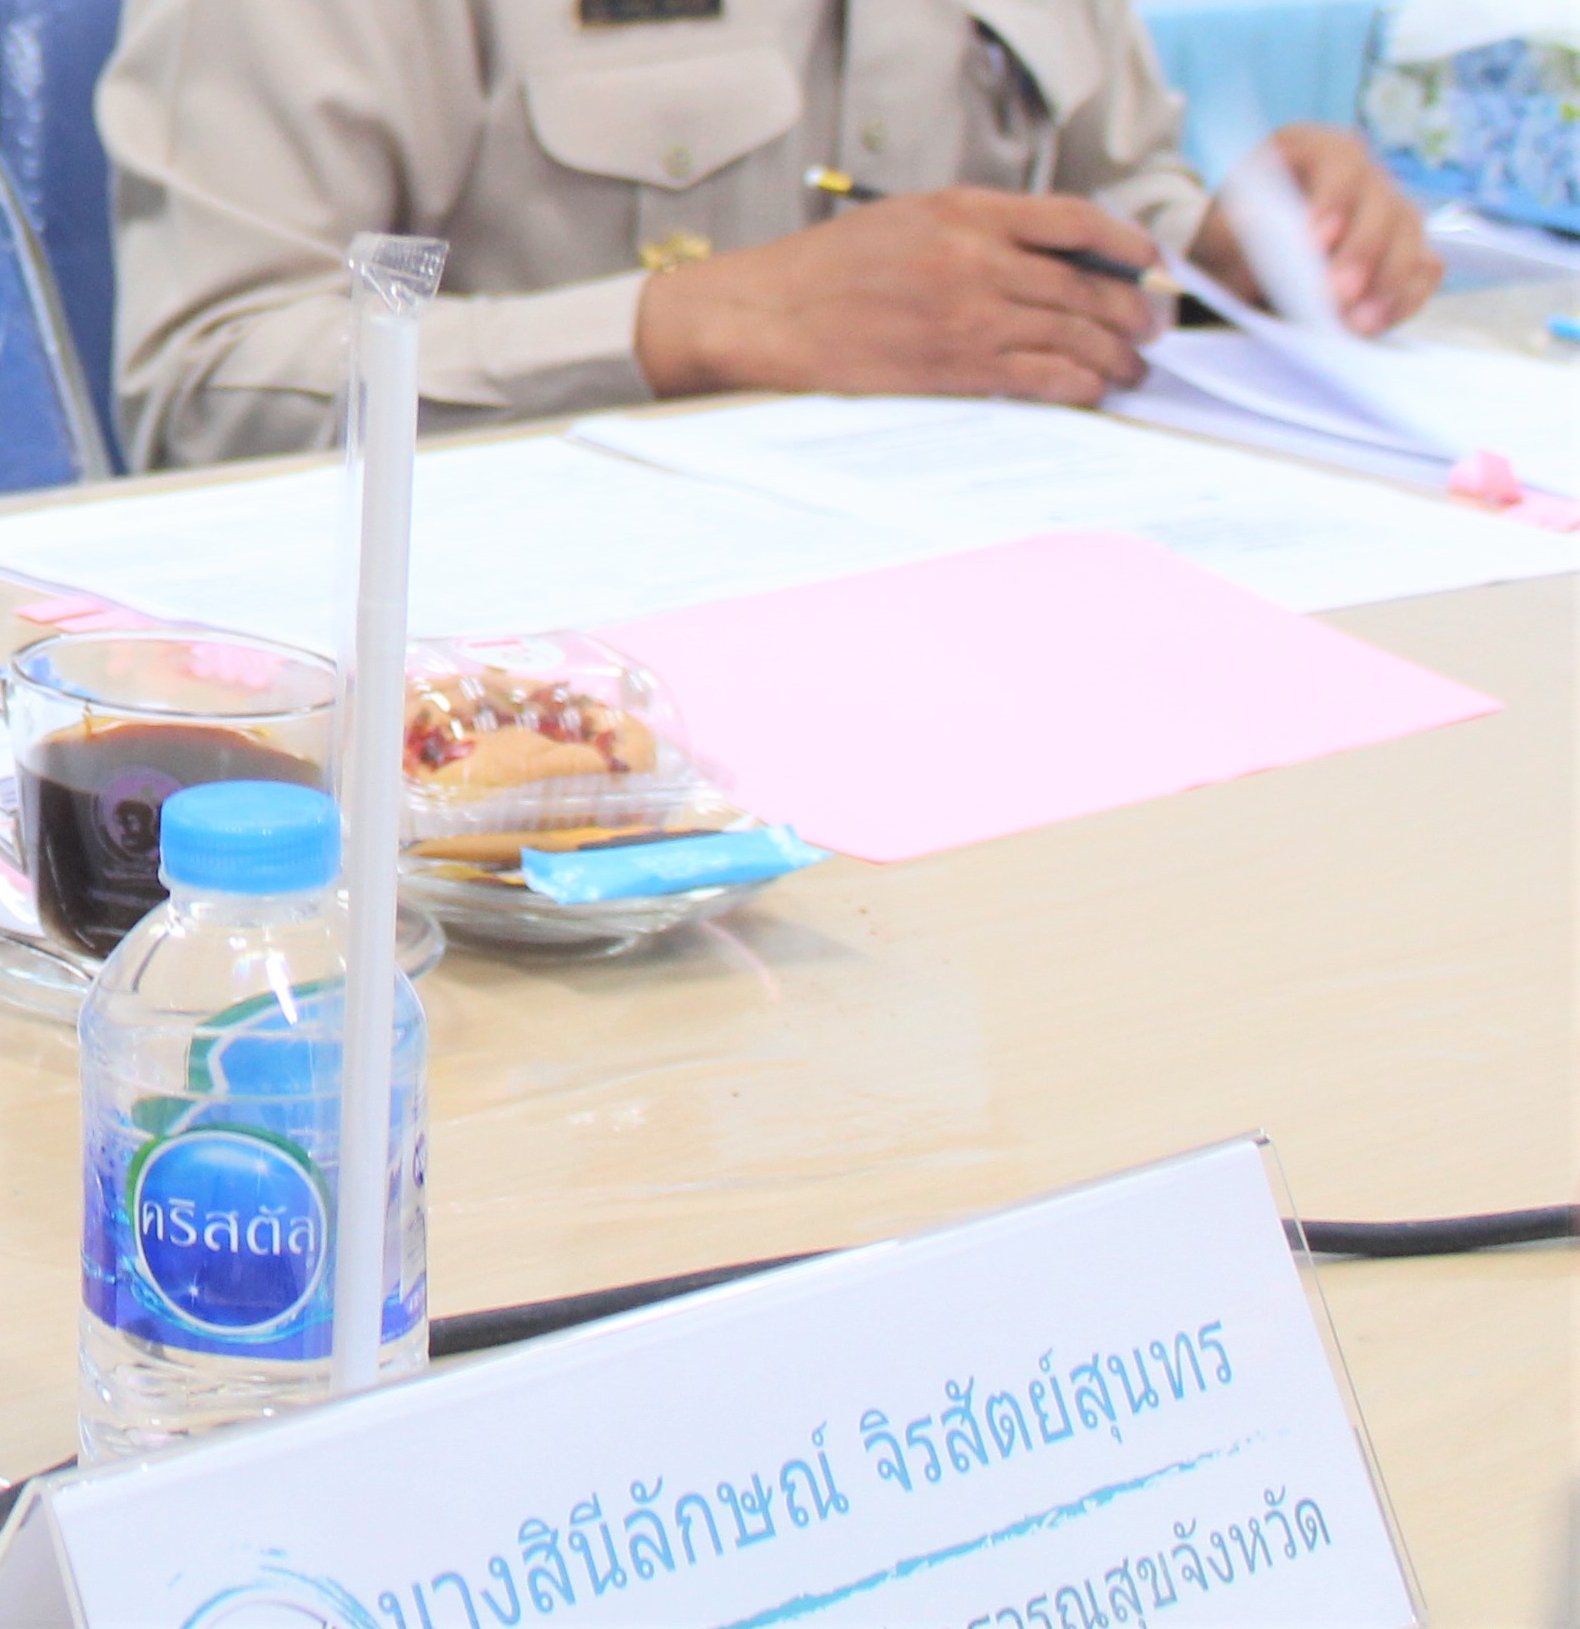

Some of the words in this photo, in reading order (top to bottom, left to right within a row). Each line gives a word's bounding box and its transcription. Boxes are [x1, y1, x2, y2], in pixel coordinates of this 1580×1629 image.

[141, 1197, 316, 1257] คริสตัล
[858, 1319, 1235, 1499] จิรสัตย์สุนทร
[967, 1485, 1335, 1629] รณสุขจังหวัด
